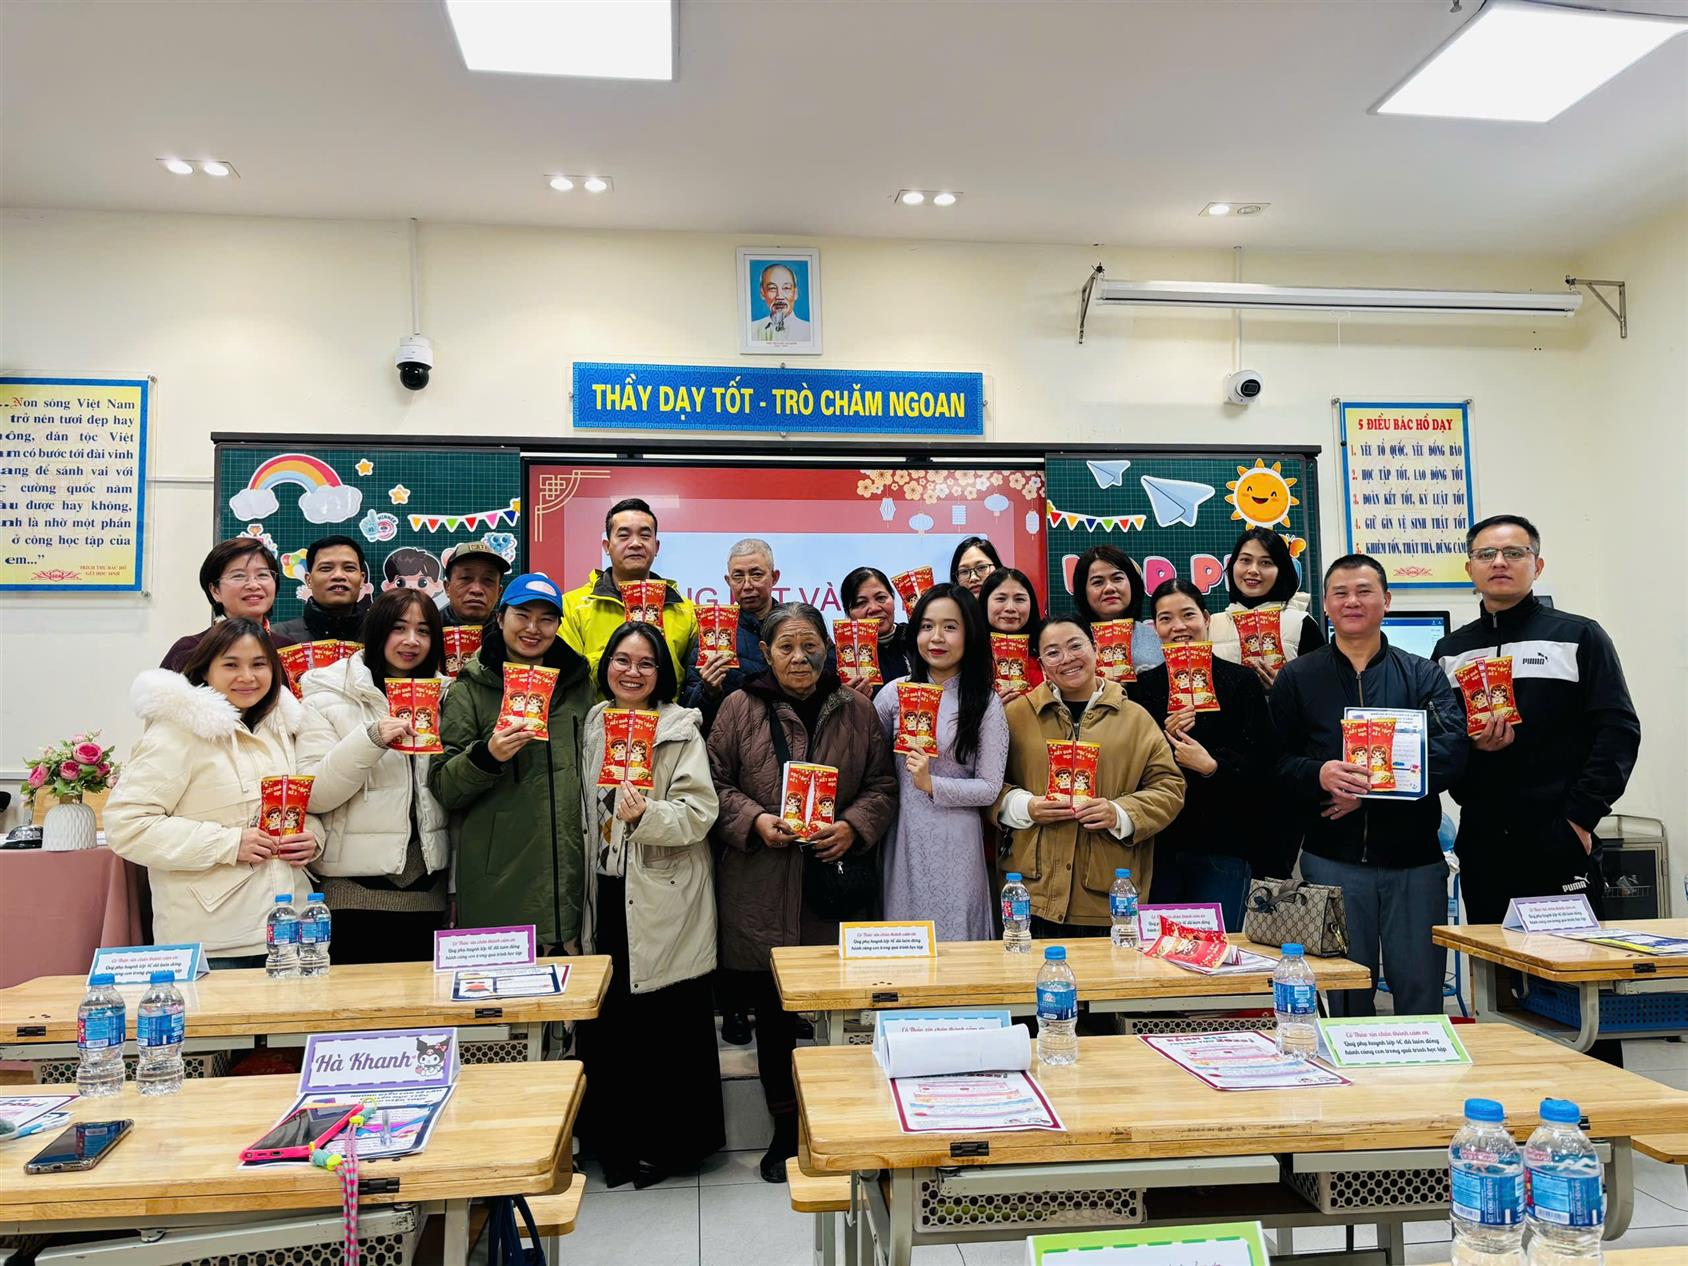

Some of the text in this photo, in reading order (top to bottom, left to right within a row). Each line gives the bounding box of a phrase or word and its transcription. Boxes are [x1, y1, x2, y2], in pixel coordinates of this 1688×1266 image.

[592, 373, 652, 411] THẦY
[660, 386, 706, 420] DẠY
[712, 376, 754, 414] TỐT
[772, 382, 814, 415] TRÒ
[820, 384, 883, 417] CHĂM
[889, 391, 965, 417] NGOAN
[44, 399, 70, 410] sông
[77, 399, 100, 411] Việt
[108, 399, 135, 409] Nam
[34, 414, 54, 423] nên
[60, 415, 82, 424] tươi
[87, 415, 108, 427] đẹp
[114, 416, 134, 427] hay
[1358, 413, 1453, 433] 5 ĐIỀU BÁC HỒ DẠY
[46, 432, 68, 441] dân
[80, 432, 98, 443] tộc
[110, 432, 134, 444] Việt
[23, 448, 36, 458] có
[39, 449, 67, 458] bước
[69, 449, 84, 458] tới
[87, 449, 105, 459] đài
[108, 450, 133, 459] vinh
[0, 464, 133, 477] ang để sánh vai với
[21, 482, 56, 494] cường
[67, 481, 96, 495] quốc
[107, 484, 133, 494] năm
[26, 500, 55, 512] được
[63, 501, 83, 512] hay
[29, 517, 39, 528] là
[45, 518, 68, 528] nhờ
[73, 519, 95, 530] một
[102, 518, 131, 530] phần
[25, 537, 53, 547] công
[59, 536, 80, 547] học
[85, 537, 104, 548] tập
[110, 535, 131, 546] của
[799, 582, 842, 611] VÀ
[1562, 881, 1587, 893] PUMA
[316, 1051, 413, 1073] Hà Khanh
